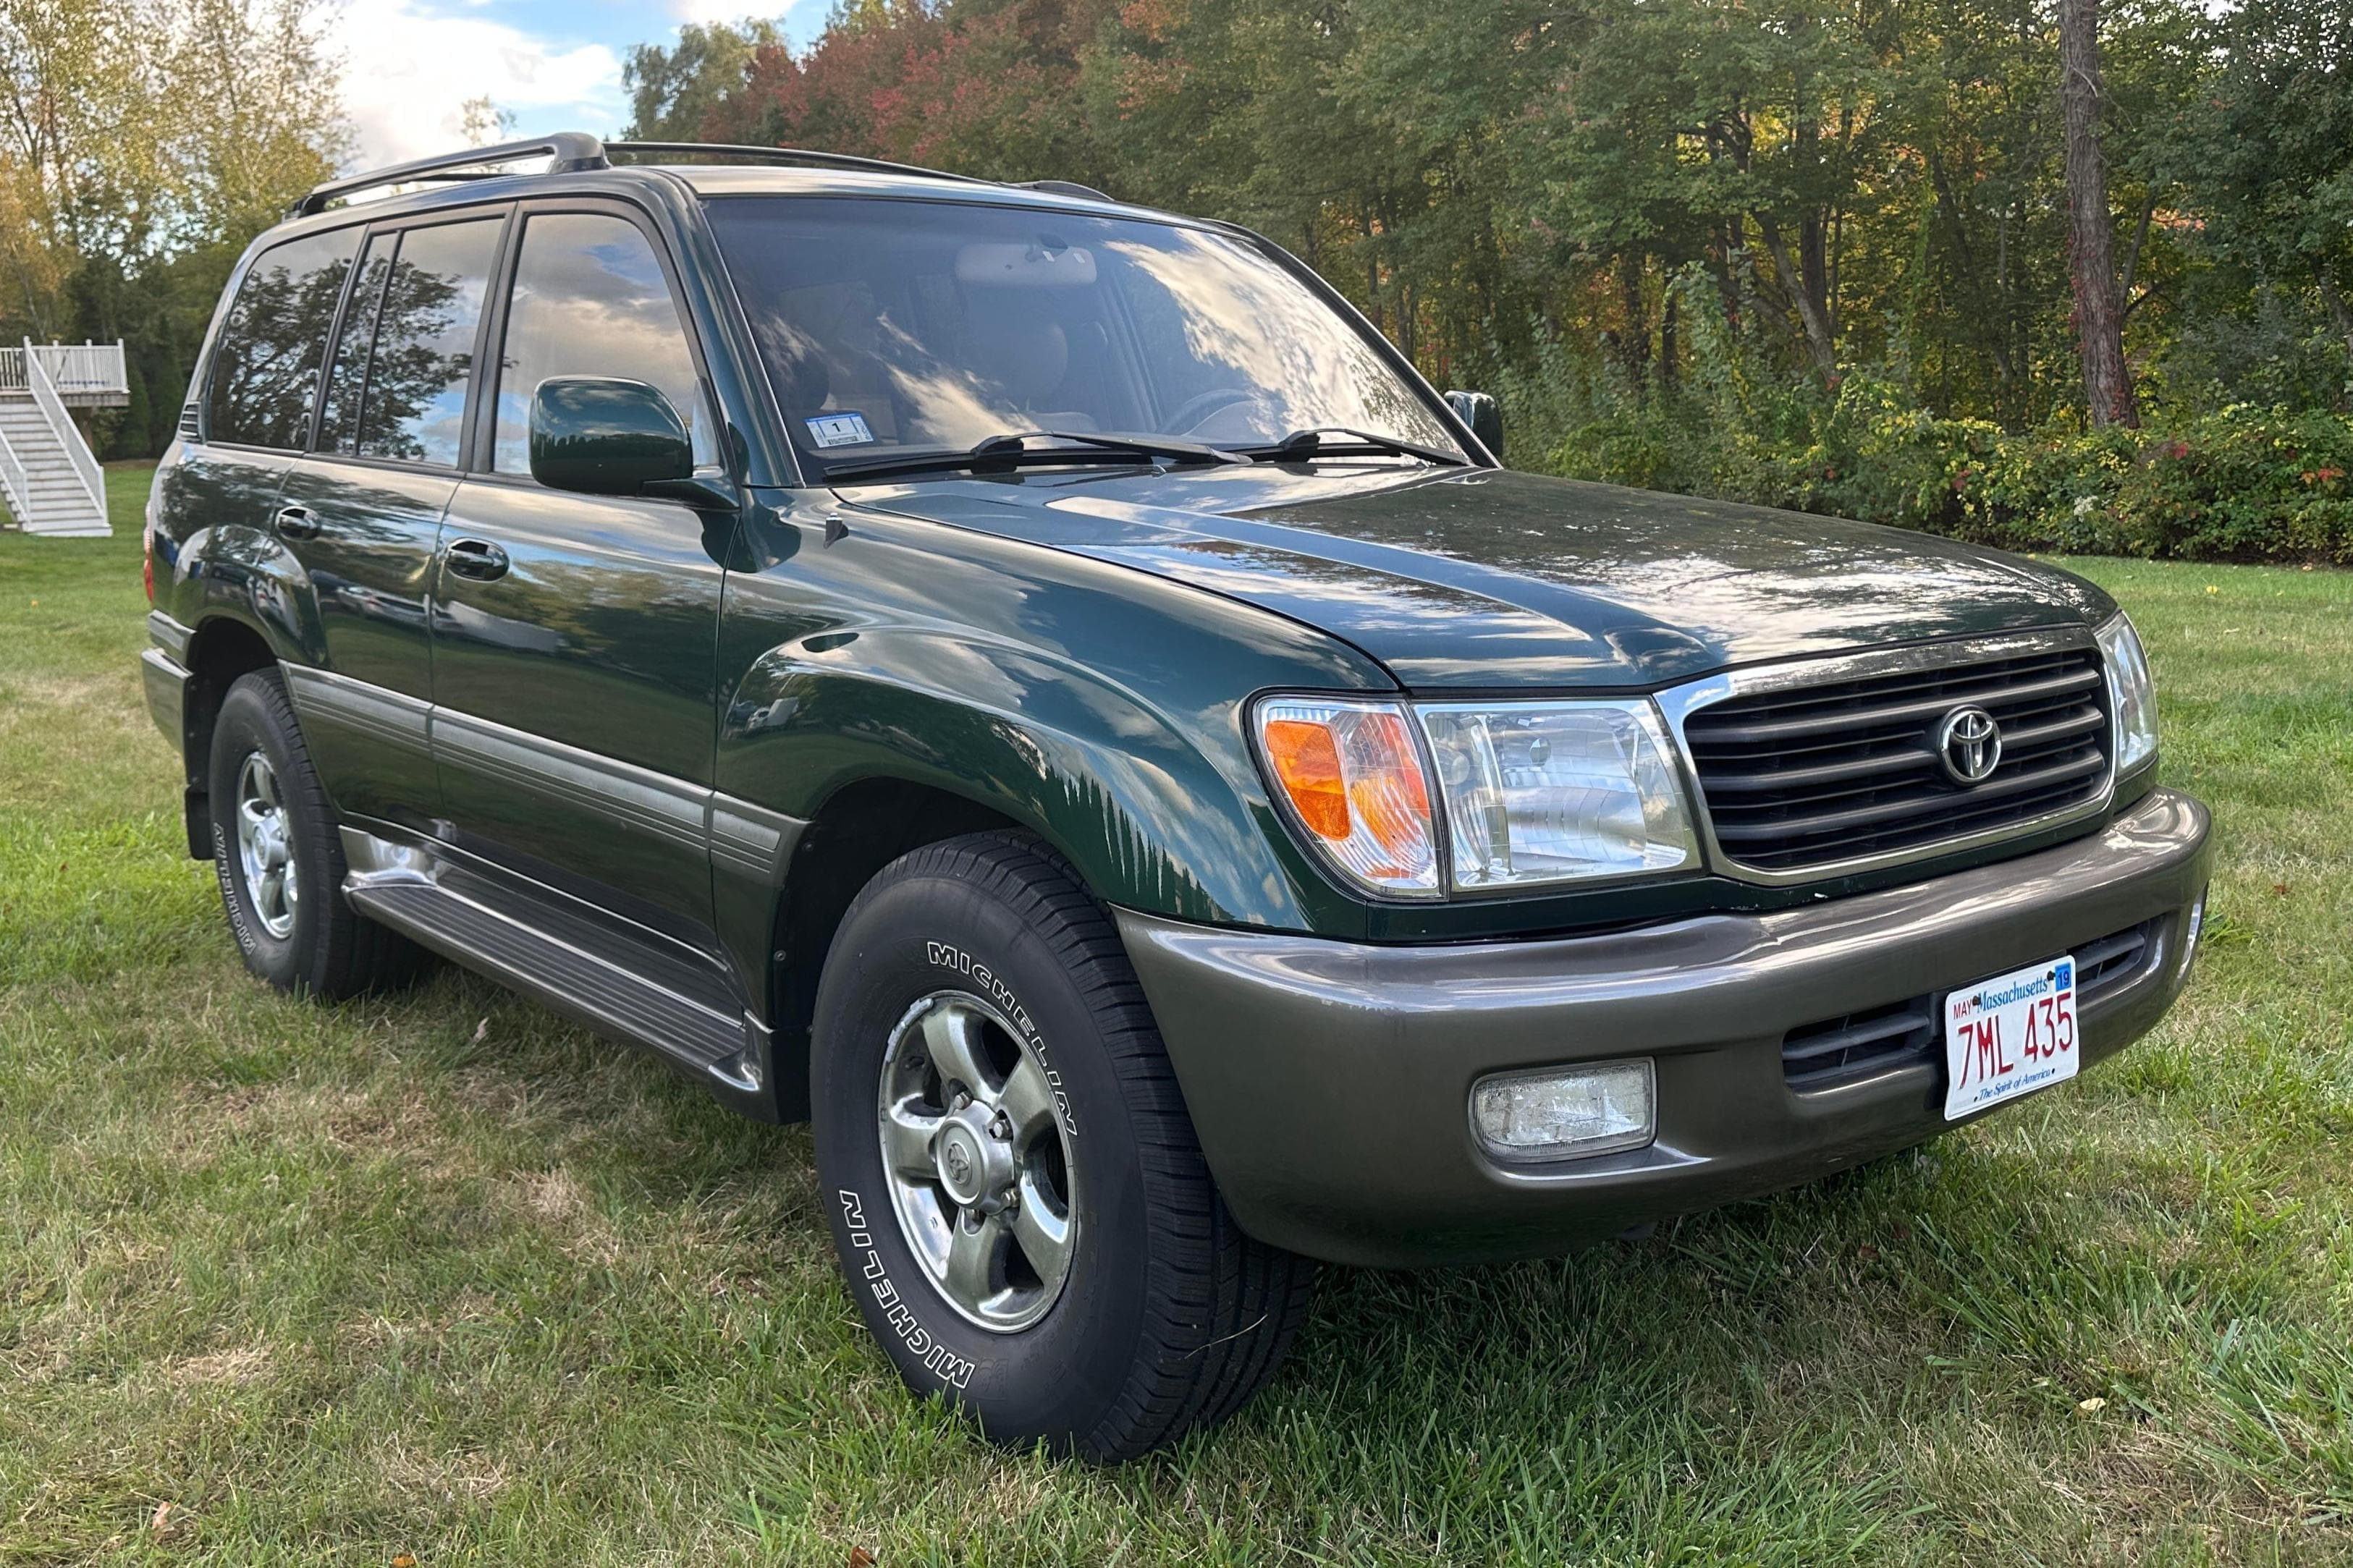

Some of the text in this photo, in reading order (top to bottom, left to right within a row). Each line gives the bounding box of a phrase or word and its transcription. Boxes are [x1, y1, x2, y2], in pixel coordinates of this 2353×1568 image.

[832, 423, 841, 432] 1
[1977, 977, 2048, 1012] Massachusetts
[2058, 970, 2071, 988] 19
[1953, 1000, 1972, 1020] MAY
[927, 941, 1078, 1136] MICHELIN
[1958, 992, 2074, 1090] 7ML 435
[1980, 1069, 2050, 1101] The Spirit of America
[839, 1190, 975, 1389] MICHELIN
